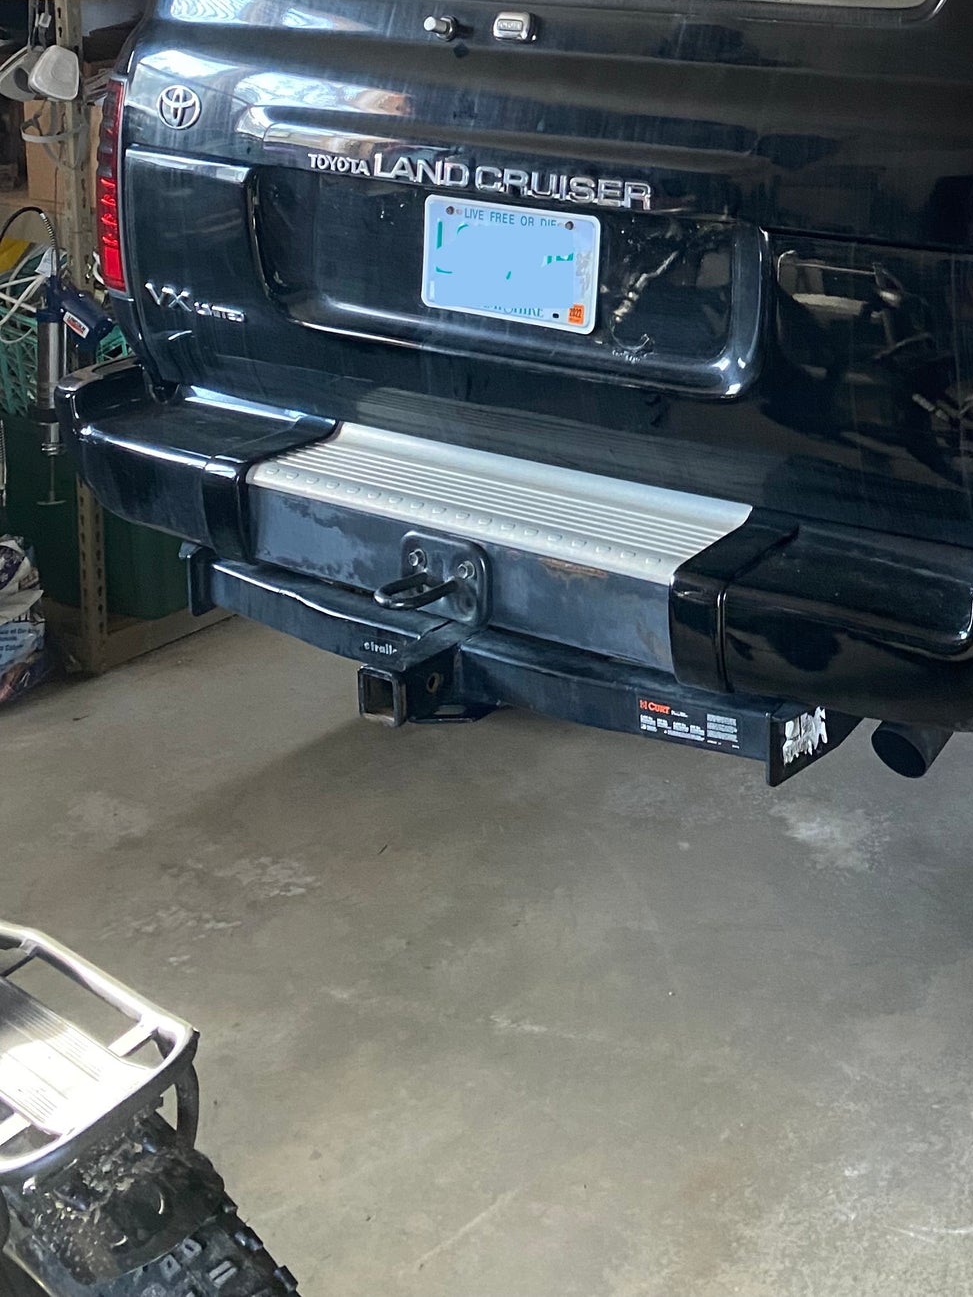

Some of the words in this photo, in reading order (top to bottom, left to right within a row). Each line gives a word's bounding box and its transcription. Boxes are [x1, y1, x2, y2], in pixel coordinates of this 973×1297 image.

[308, 153, 370, 176] TOYOTA
[374, 153, 469, 188] LAND
[475, 166, 651, 212] CRUISER
[465, 208, 484, 221] LIVE
[490, 211, 515, 225] FREE
[521, 215, 535, 227] OR
[144, 282, 192, 312] VX
[648, 702, 671, 714] CURT
